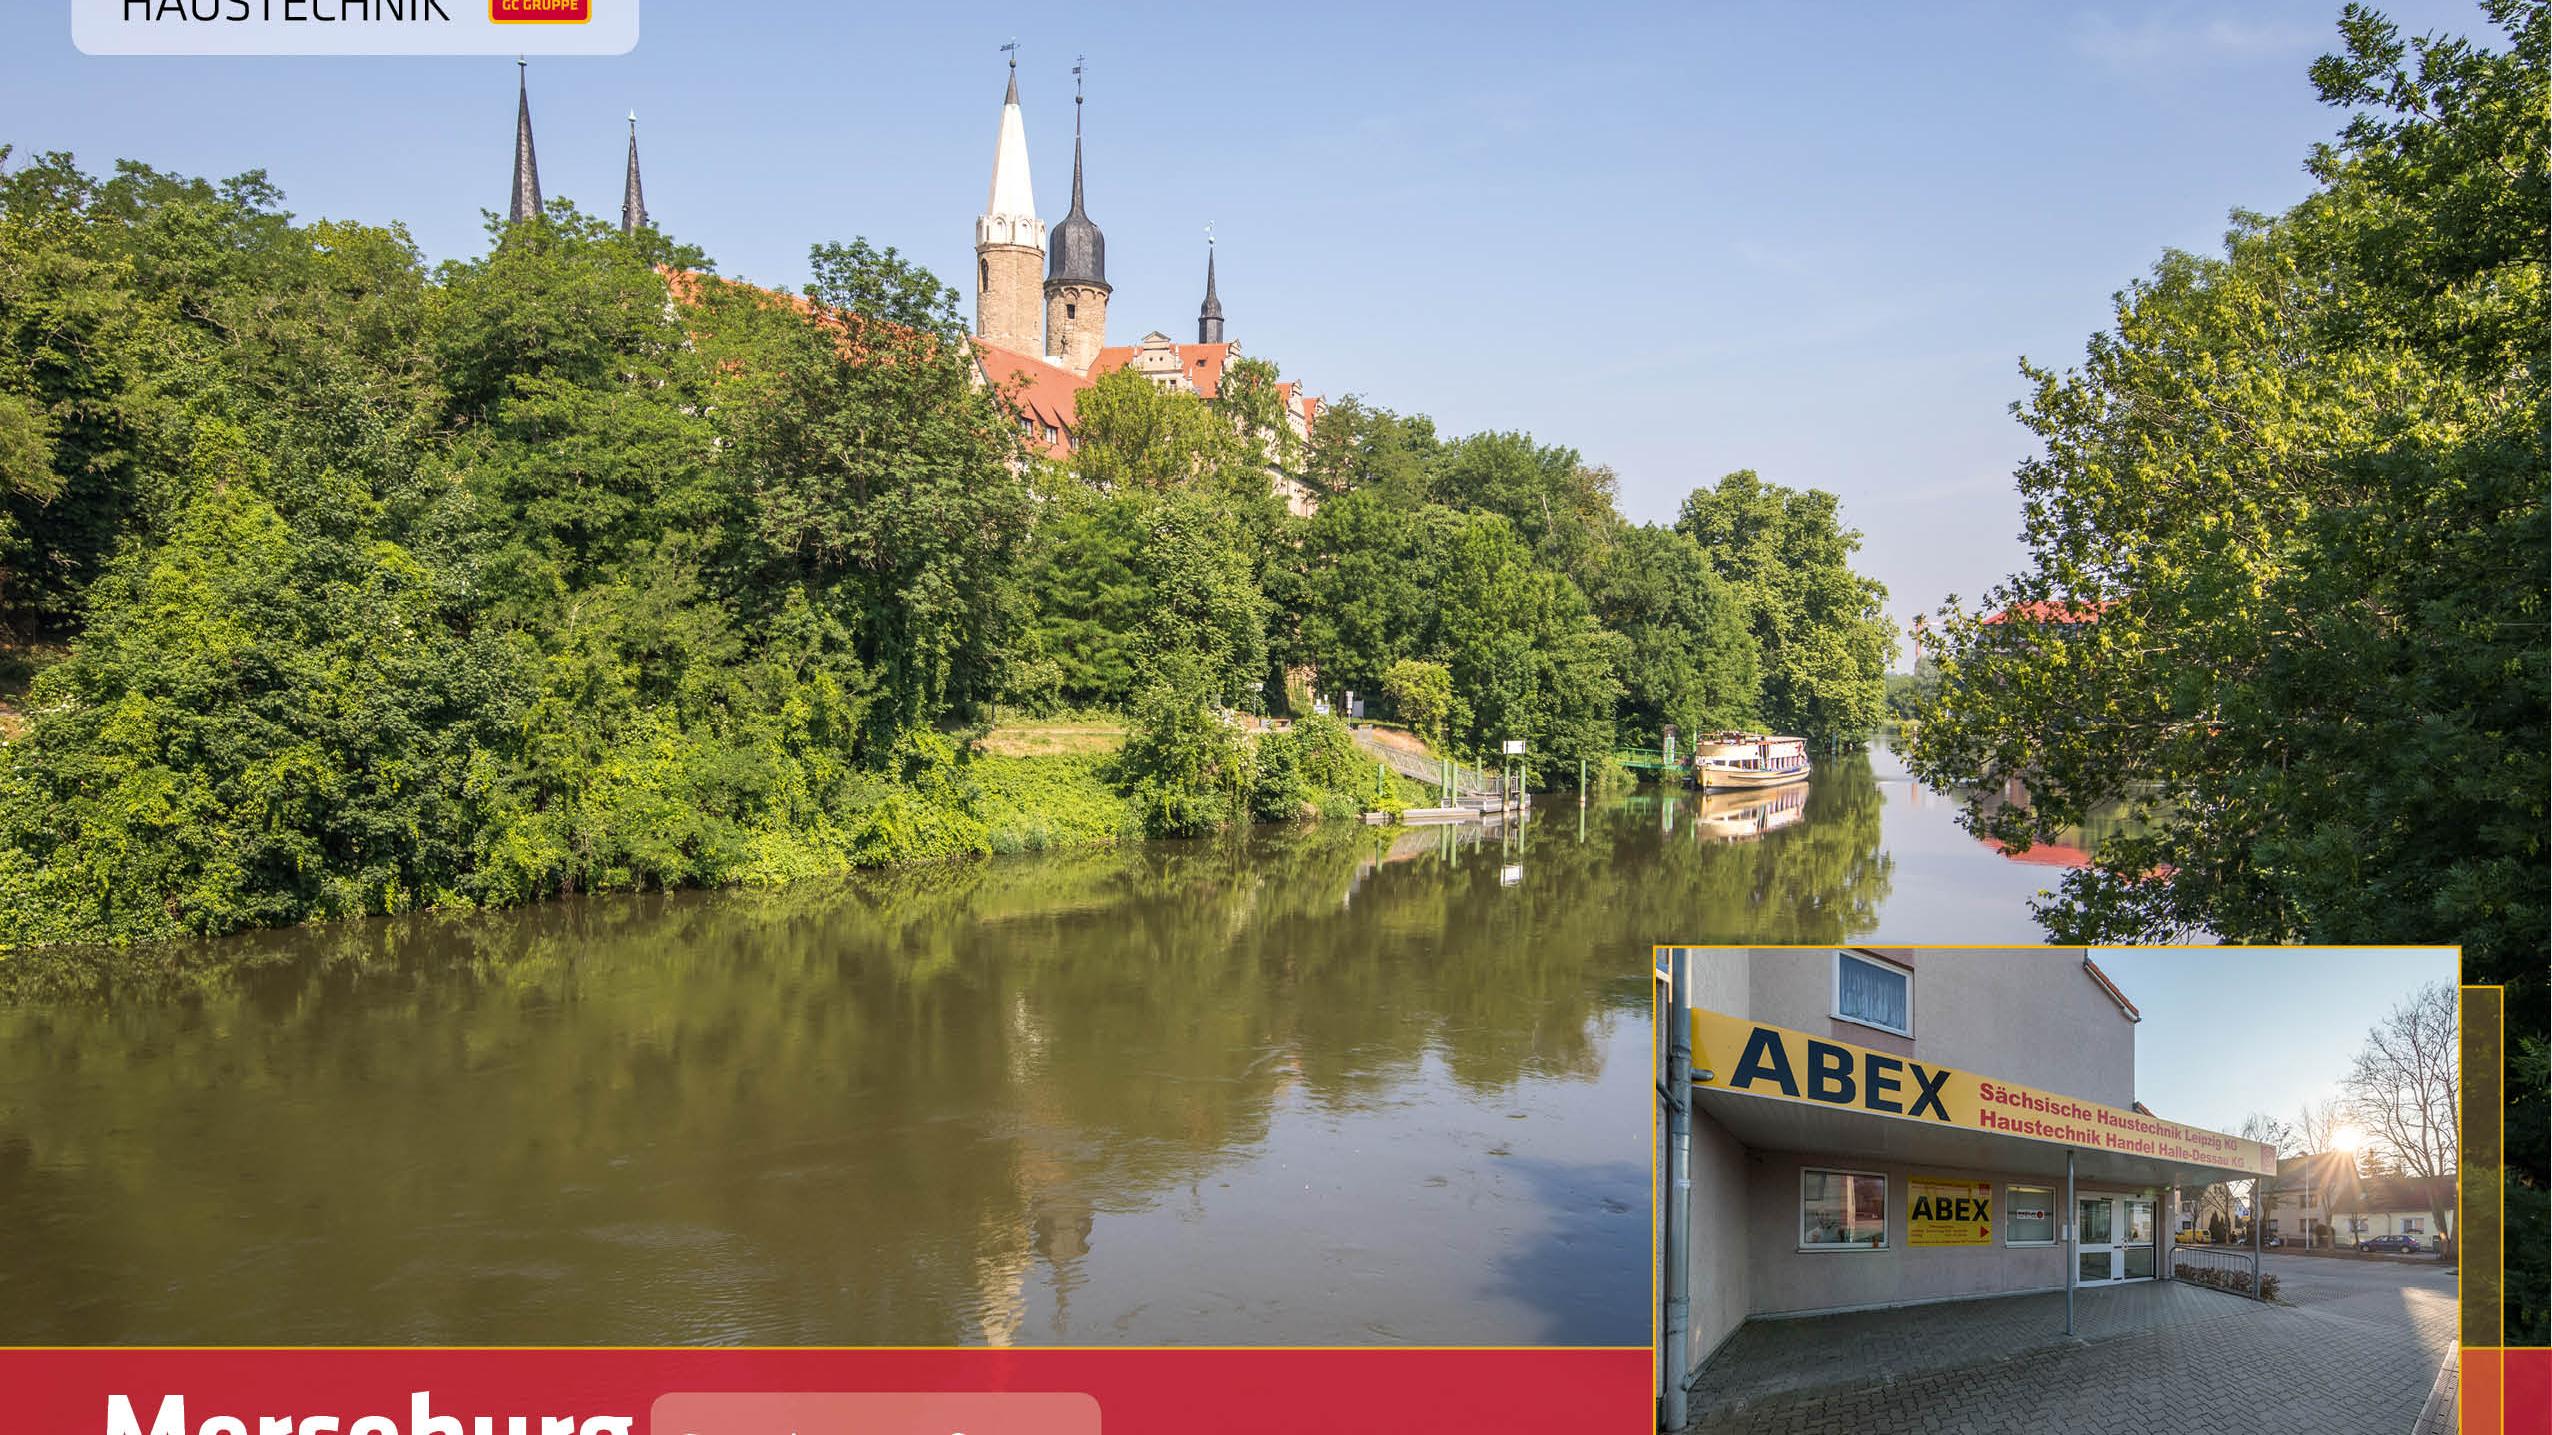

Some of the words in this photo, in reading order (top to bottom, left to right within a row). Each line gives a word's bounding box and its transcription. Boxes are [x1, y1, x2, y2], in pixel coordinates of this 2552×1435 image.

[1729, 1026, 1951, 1122] ABEX
[1980, 1082, 2092, 1121] Sächsische
[2097, 1109, 2181, 1140] Haustechnik
[2185, 1129, 2221, 1151] Leipzig
[2224, 1138, 2237, 1151] KG
[1980, 1109, 2101, 1146] Haustechnik
[2106, 1132, 2155, 1154] Handel
[2160, 1142, 2229, 1166] Halle-Dessau
[2231, 1156, 2246, 1168] KG
[1912, 1195, 1989, 1222] ABEX
